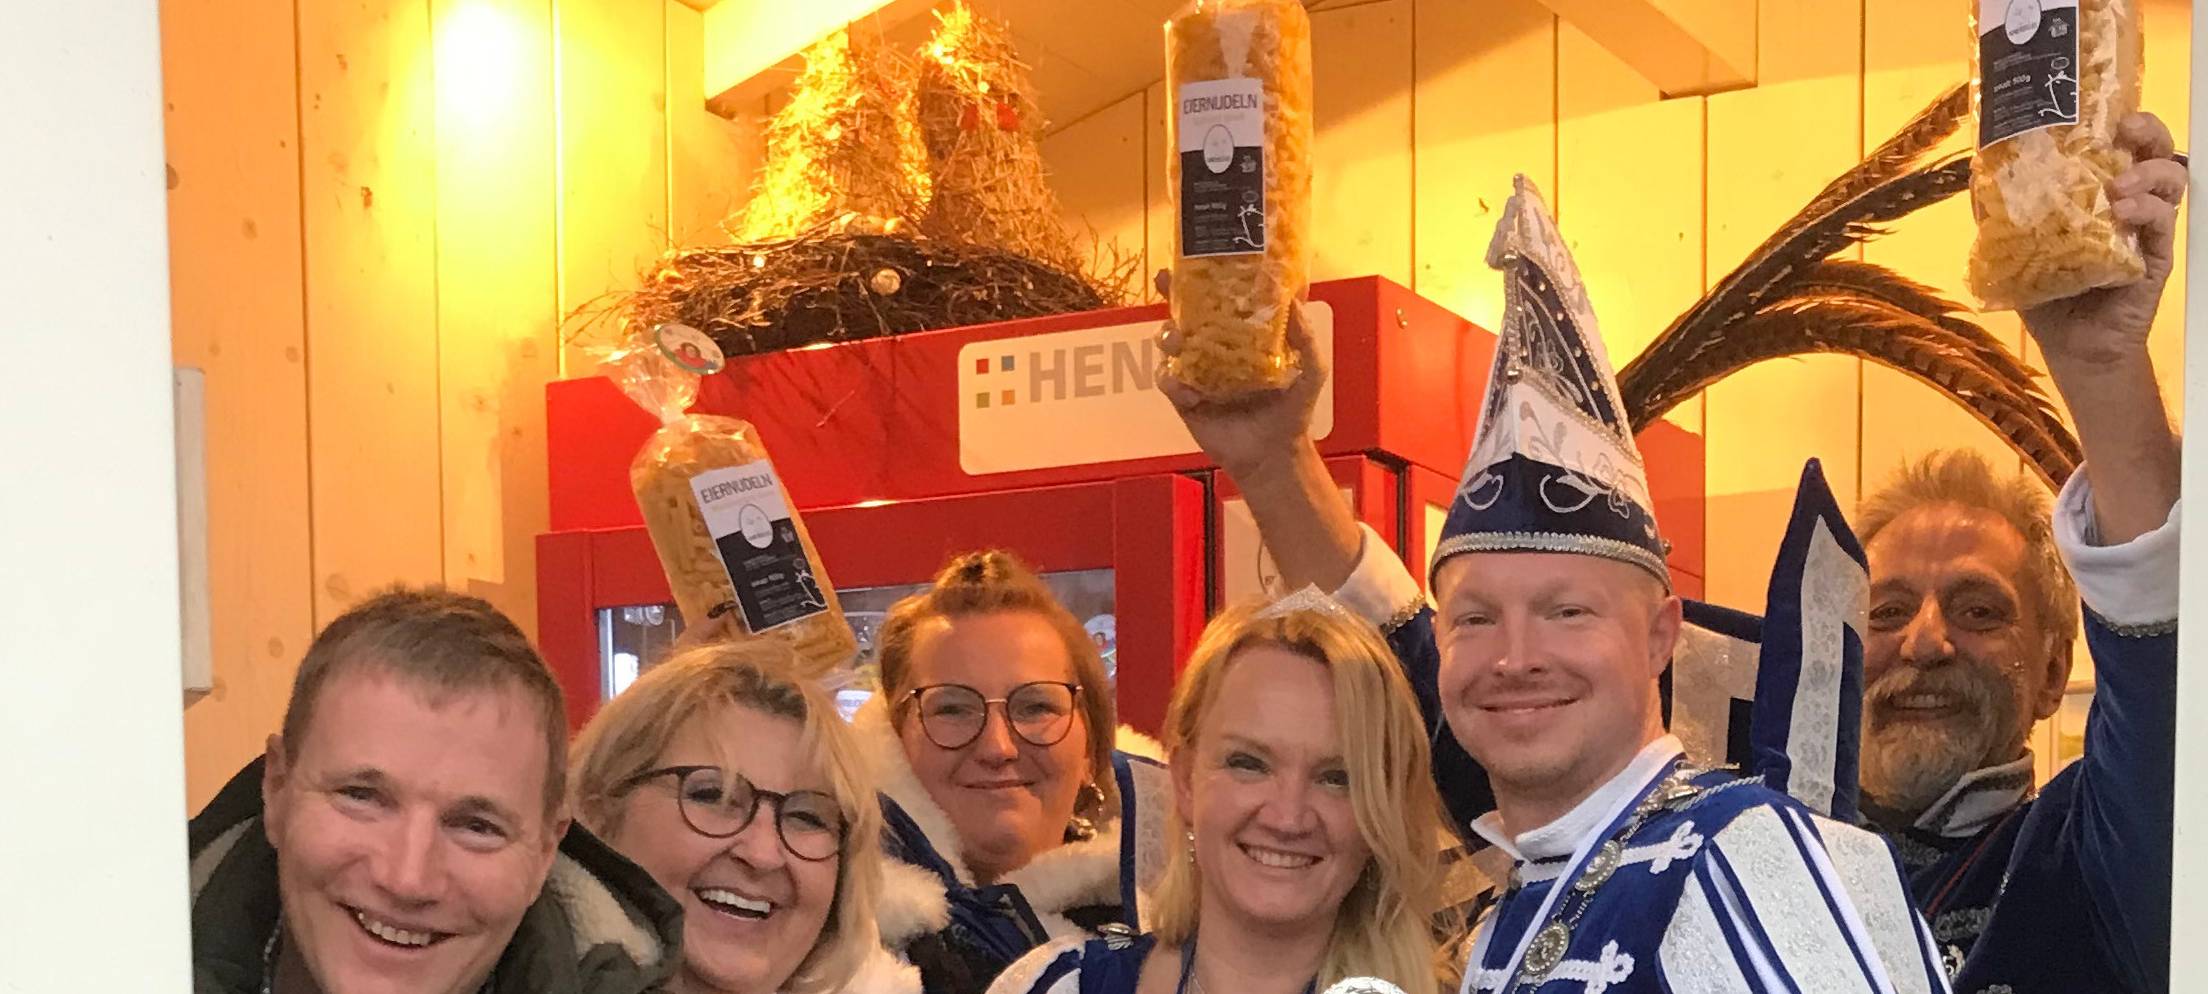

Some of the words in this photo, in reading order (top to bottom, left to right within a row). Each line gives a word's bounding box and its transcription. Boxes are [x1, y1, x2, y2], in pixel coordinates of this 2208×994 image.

[1183, 93, 1258, 115] EIERNUDELN
[1029, 338, 1154, 403] HEN
[700, 473, 773, 504] EIERNUDELN
